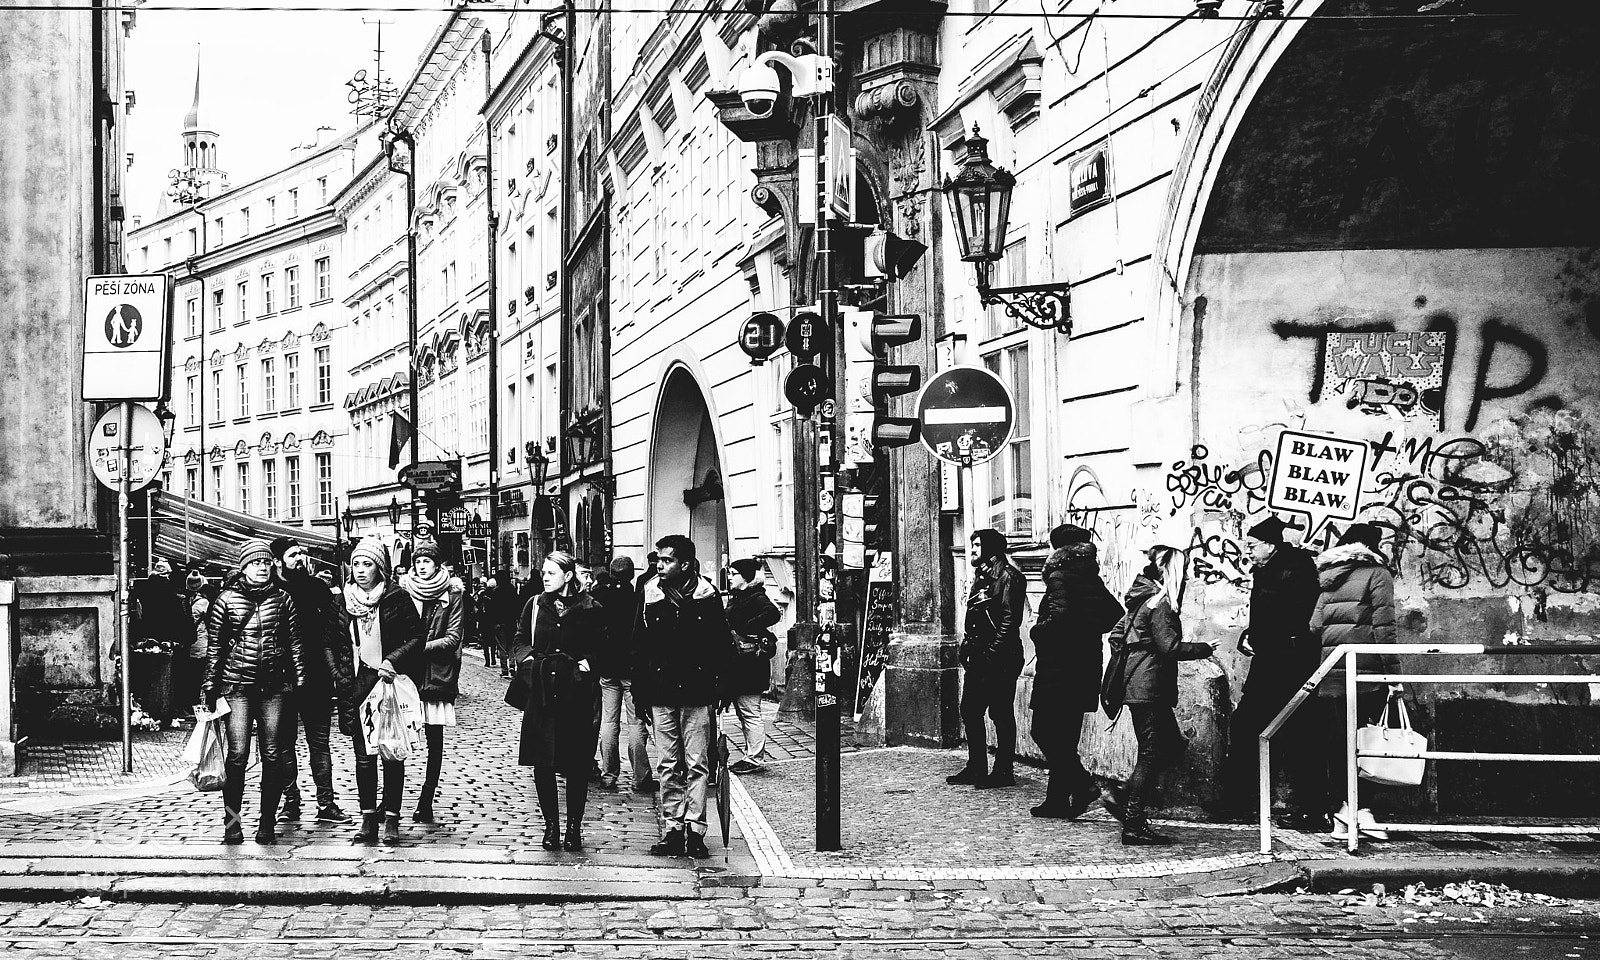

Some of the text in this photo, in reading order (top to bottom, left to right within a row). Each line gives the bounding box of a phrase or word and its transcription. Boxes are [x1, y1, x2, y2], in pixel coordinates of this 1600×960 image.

[95, 279, 155, 295] PĚŠÍ ZÓNA
[746, 323, 775, 348] 21
[1332, 332, 1441, 355] FUCK
[1333, 355, 1441, 378] WARS
[1291, 440, 1354, 463] BLAW
[1288, 464, 1350, 487] BLAW
